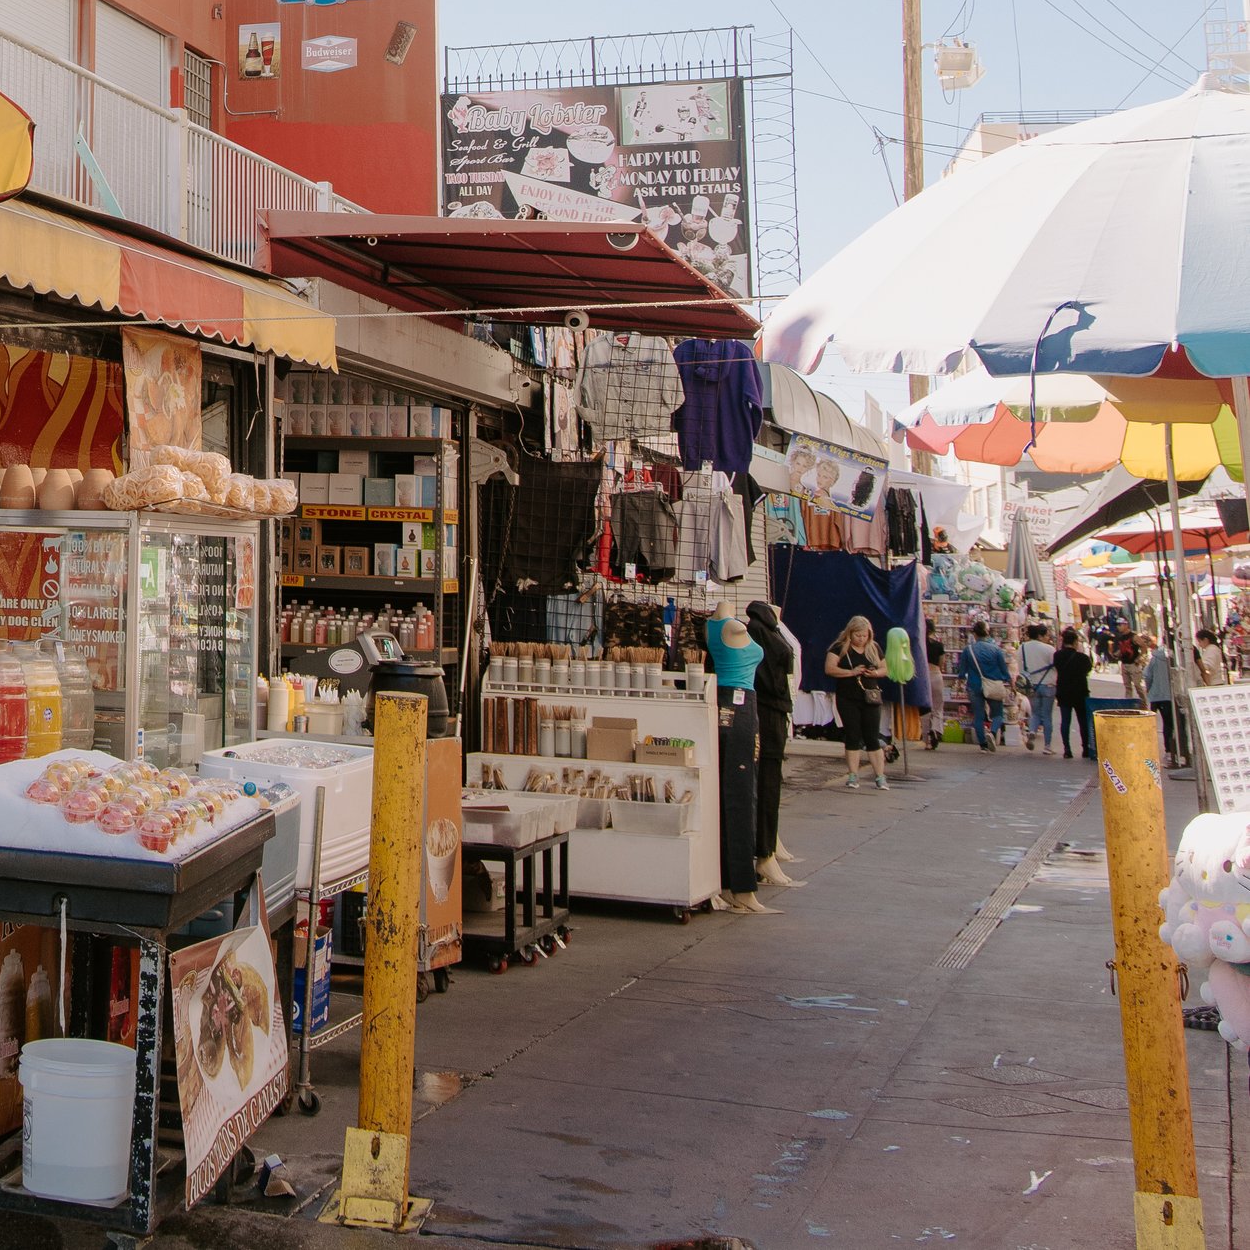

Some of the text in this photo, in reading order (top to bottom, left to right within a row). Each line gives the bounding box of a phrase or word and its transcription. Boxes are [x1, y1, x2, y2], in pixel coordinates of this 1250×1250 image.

[306, 47, 352, 58] Budweiser
[470, 102, 607, 136] Baby Lobster
[448, 139, 488, 152] Seafood
[512, 136, 540, 151] Grill
[619, 150, 701, 167] HAPPY HOUR
[445, 172, 468, 184] TACO
[619, 166, 741, 186] MONDAY TO FRIDAY
[459, 186, 492, 197] ALL DAY
[520, 185, 553, 200] ENJOY
[633, 183, 741, 197] ASK FOR DETAILS
[305, 509, 429, 520] STONE CRYSTAL
[146, 560, 155, 588] A
[1, 599, 18, 610] ARE
[21, 599, 45, 610] ONLY
[8, 616, 29, 627] DOG
[92, 629, 126, 643] SMOKED
[190, 1148, 216, 1206] RICOS
[235, 1108, 250, 1142] DE
